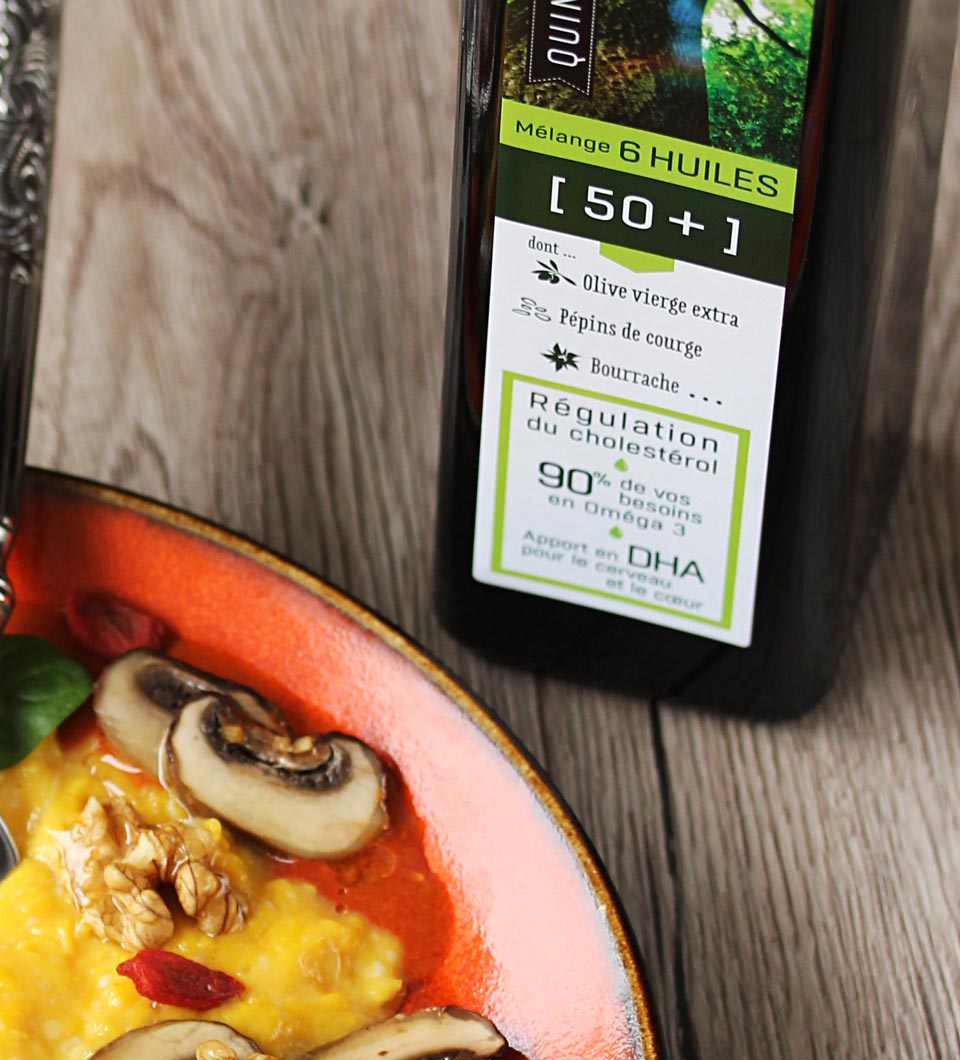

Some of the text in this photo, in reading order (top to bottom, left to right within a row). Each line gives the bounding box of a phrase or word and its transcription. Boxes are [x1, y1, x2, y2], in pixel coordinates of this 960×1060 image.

[516, 119, 779, 198] Mélange 6 HUILES
[528, 236, 560, 256] dont
[582, 273, 740, 328] Olive vierge extra
[559, 307, 703, 359] Pépins de courge
[590, 357, 680, 394] Bourrache
[529, 391, 719, 453] Régulation
[526, 416, 718, 475] du cholestérol
[619, 492, 703, 525] besoins
[620, 478, 646, 496] de
[654, 487, 691, 507] vos
[548, 493, 686, 538] en Oméga 3
[520, 545, 673, 590] pour le cerveau
[522, 529, 705, 584] Apport en DHA
[605, 577, 626, 590] et
